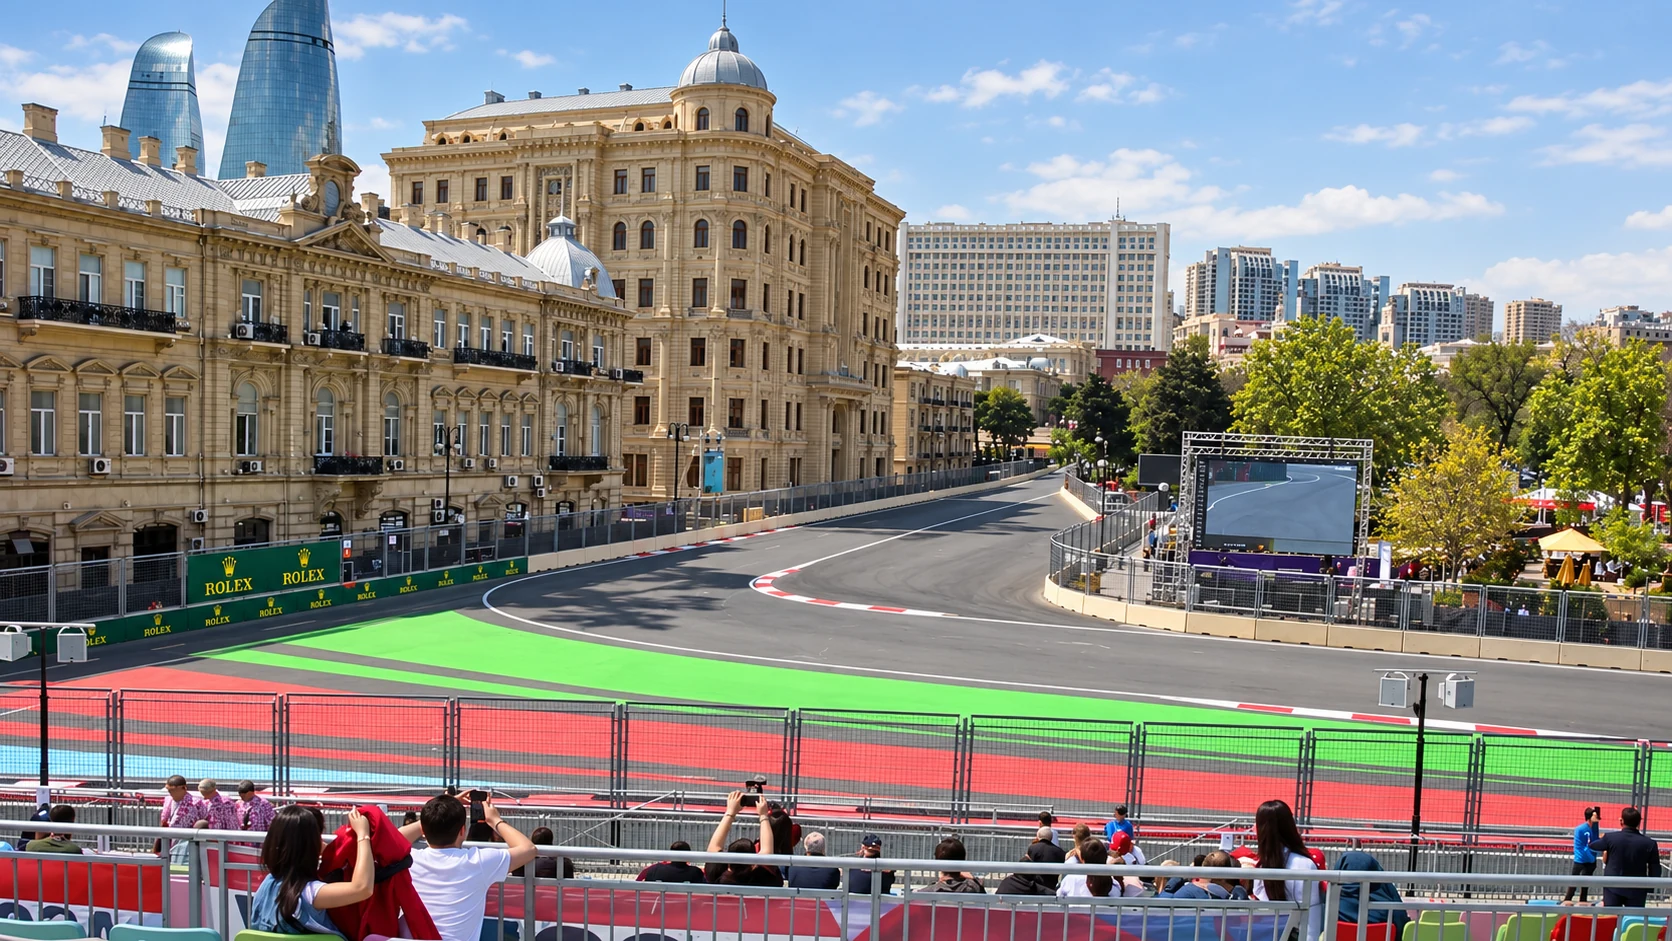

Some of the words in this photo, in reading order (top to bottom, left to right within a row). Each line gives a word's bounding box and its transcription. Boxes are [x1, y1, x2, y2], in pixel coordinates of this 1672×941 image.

[283, 569, 325, 585] ROLEX
[205, 578, 253, 596] ROLEX
[259, 607, 283, 618] ROLEX
[205, 616, 230, 627] ROLEX
[144, 625, 171, 637] ROLEX
[85, 635, 107, 647] OLEX
